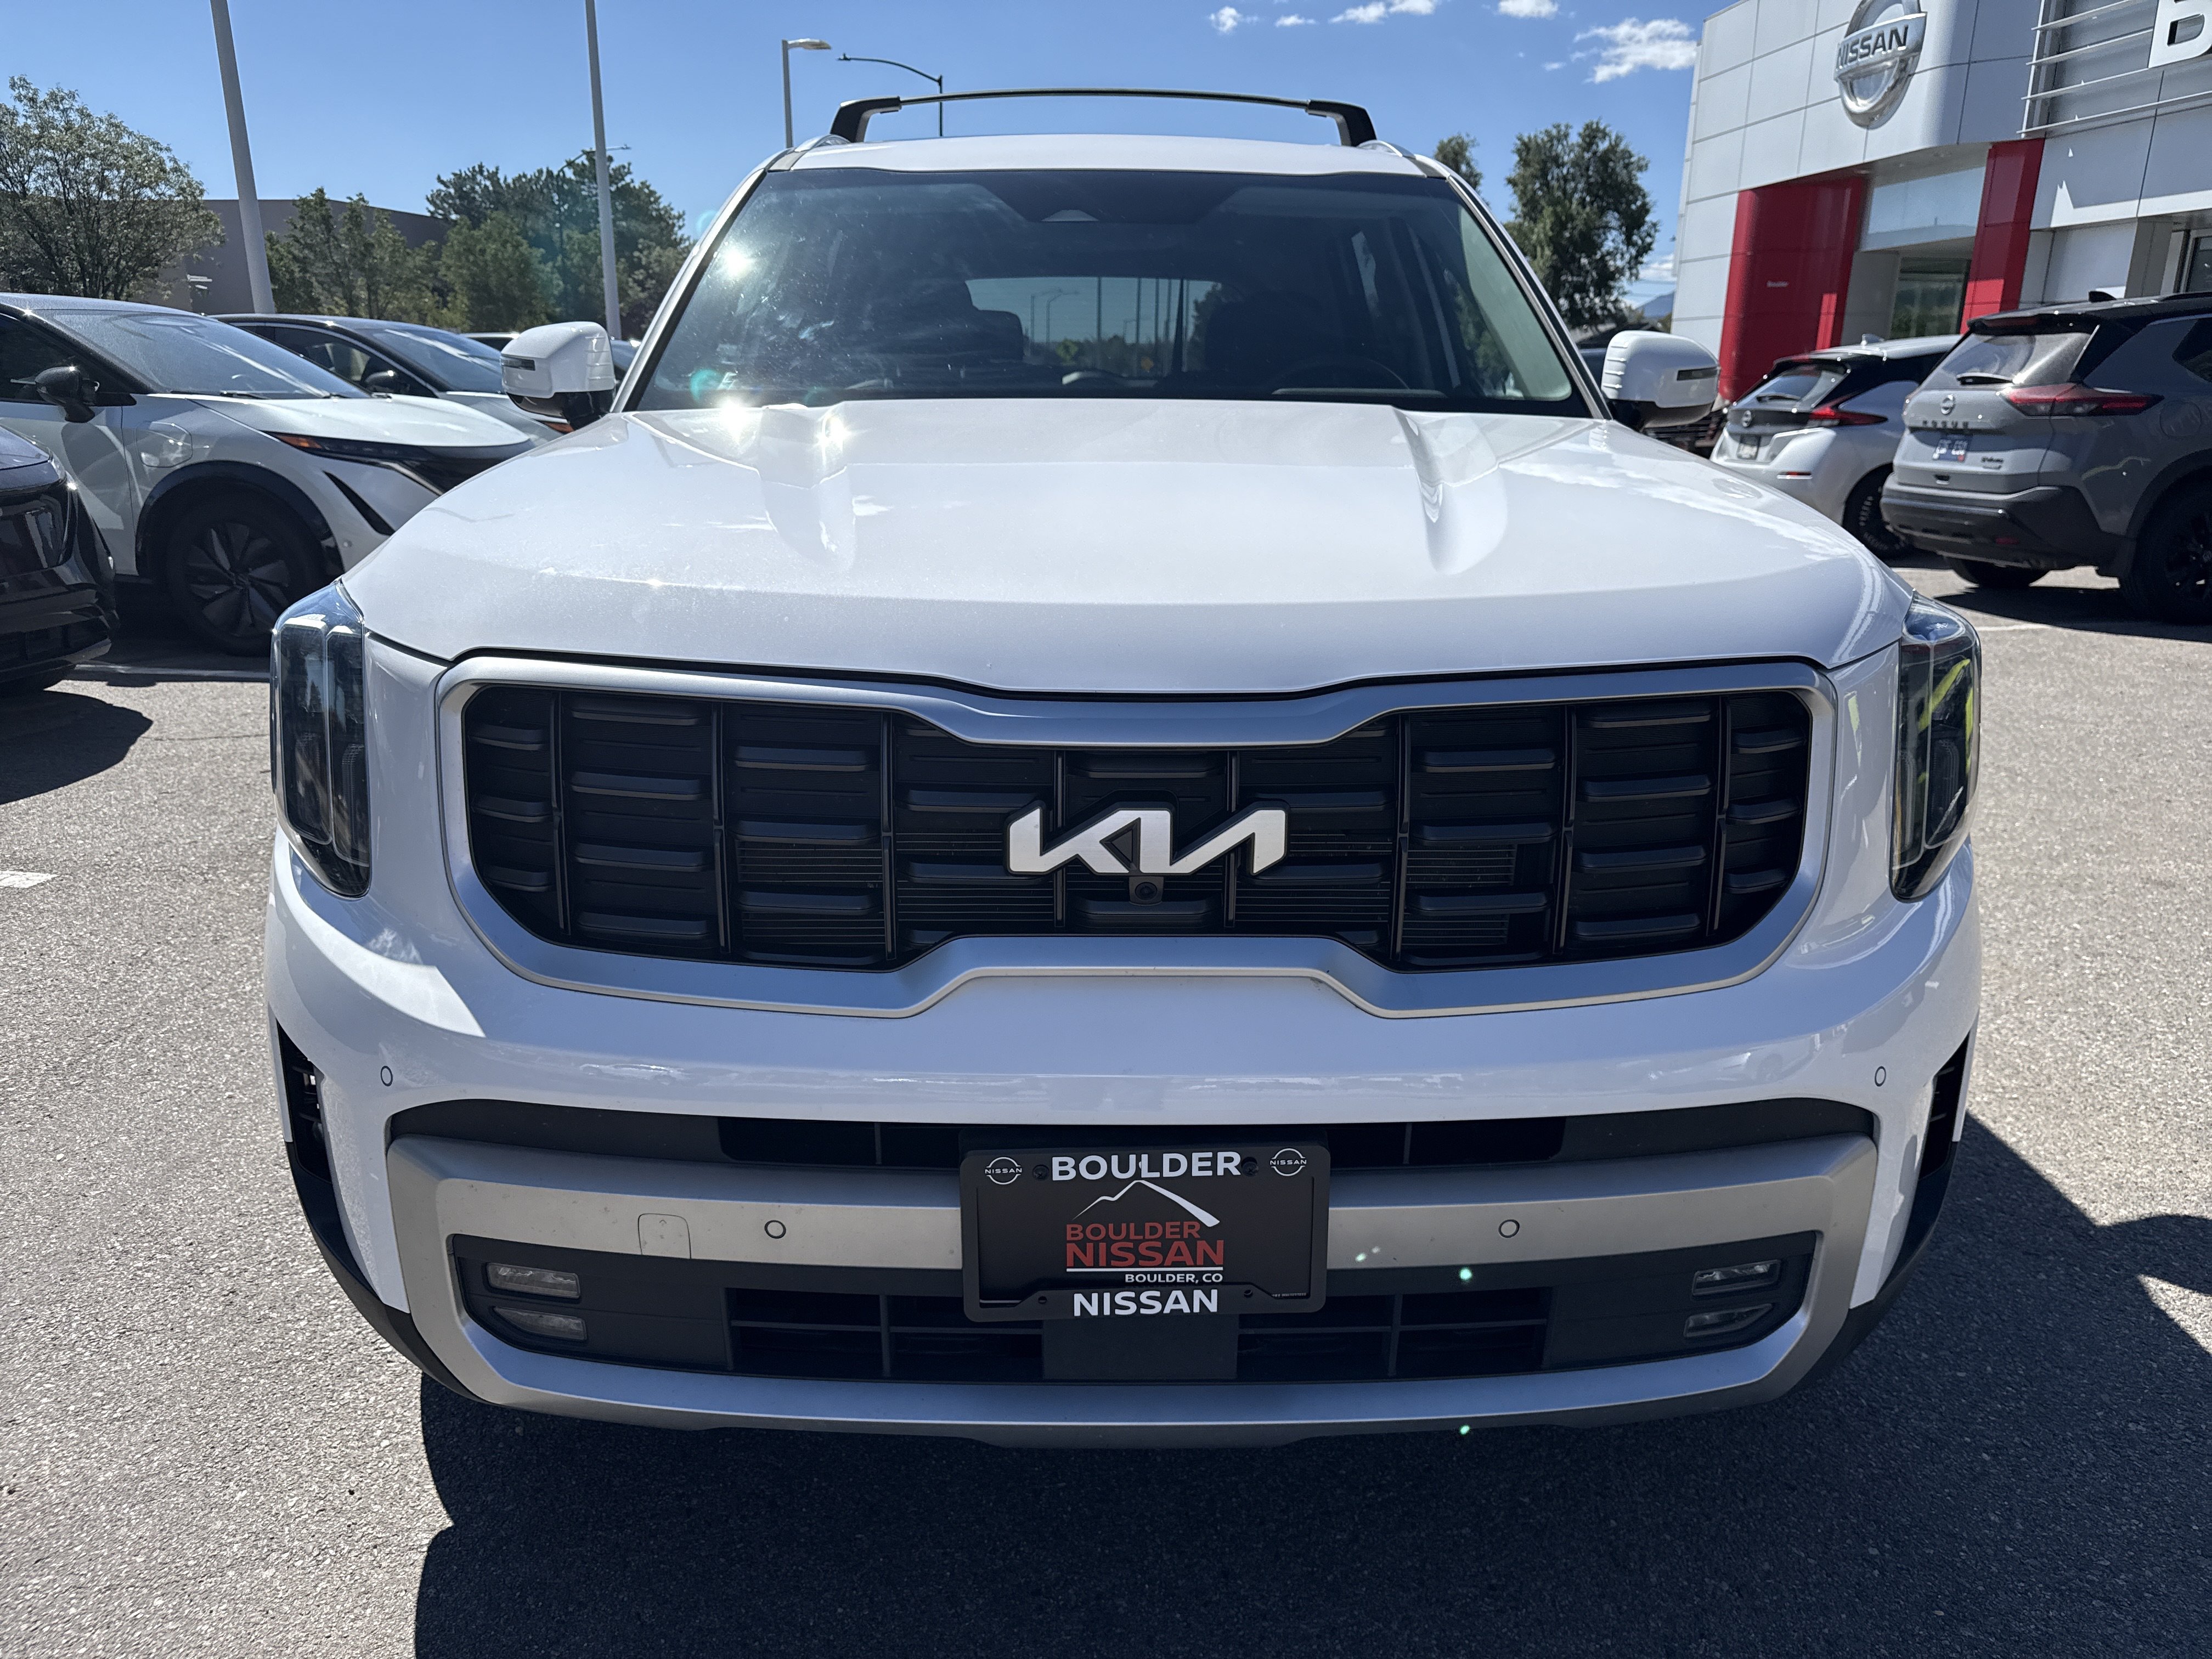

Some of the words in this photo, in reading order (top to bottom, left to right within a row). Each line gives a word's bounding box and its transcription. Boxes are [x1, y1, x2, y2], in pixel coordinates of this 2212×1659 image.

[1836, 24, 1909, 69] NISSAN
[1009, 808, 1286, 874] KIA
[1052, 1152, 1241, 1181] BOULDER
[1269, 1159, 1307, 1167] NISSAN
[1066, 1222, 1201, 1241] BOULDER
[1066, 1240, 1224, 1267] NISSAN
[1125, 1274, 1199, 1284] BOULDER,
[1202, 1273, 1223, 1283] CO
[1074, 1289, 1218, 1317] NISSAN
